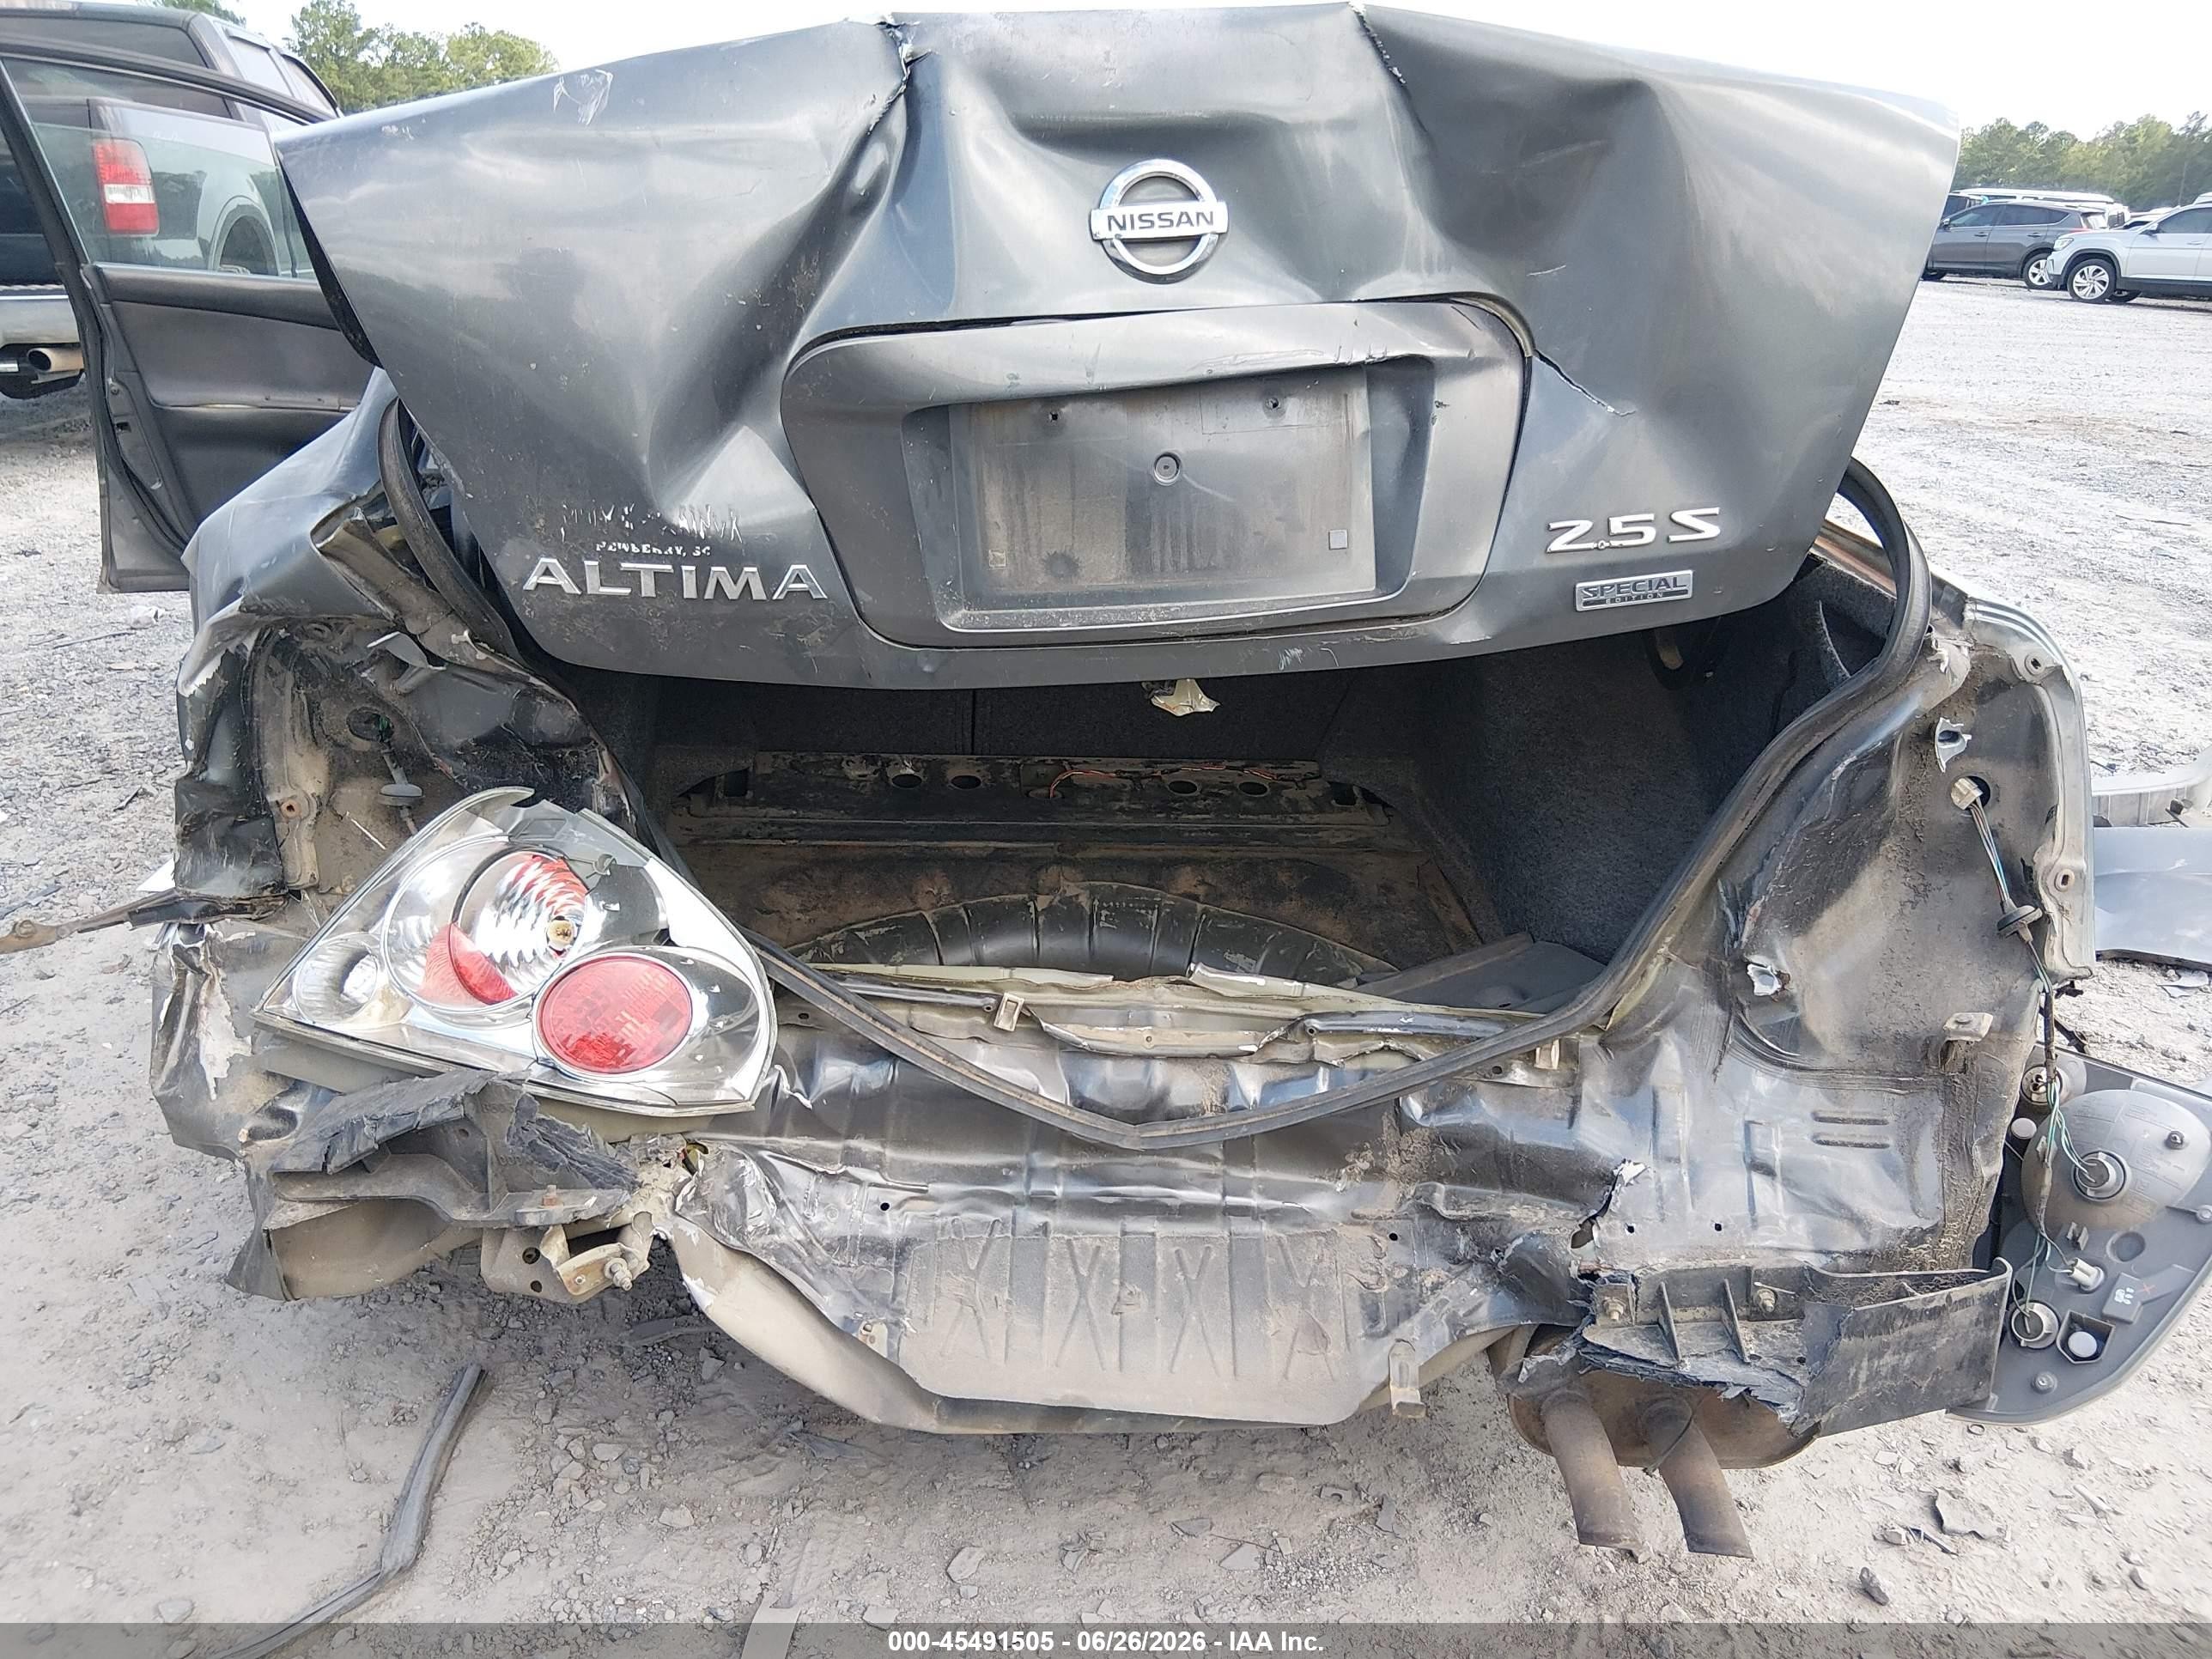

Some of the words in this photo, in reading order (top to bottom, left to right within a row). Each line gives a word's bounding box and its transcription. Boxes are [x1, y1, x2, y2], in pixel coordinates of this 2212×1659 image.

[1107, 211, 1214, 232] NISSAN
[1546, 514, 1656, 553] 2.5
[1668, 507, 1721, 543] S
[692, 545, 712, 556] SC
[523, 556, 828, 601] ALTIMA
[1582, 576, 1687, 599] SPECIAL
[1605, 592, 1664, 605] EDITION
